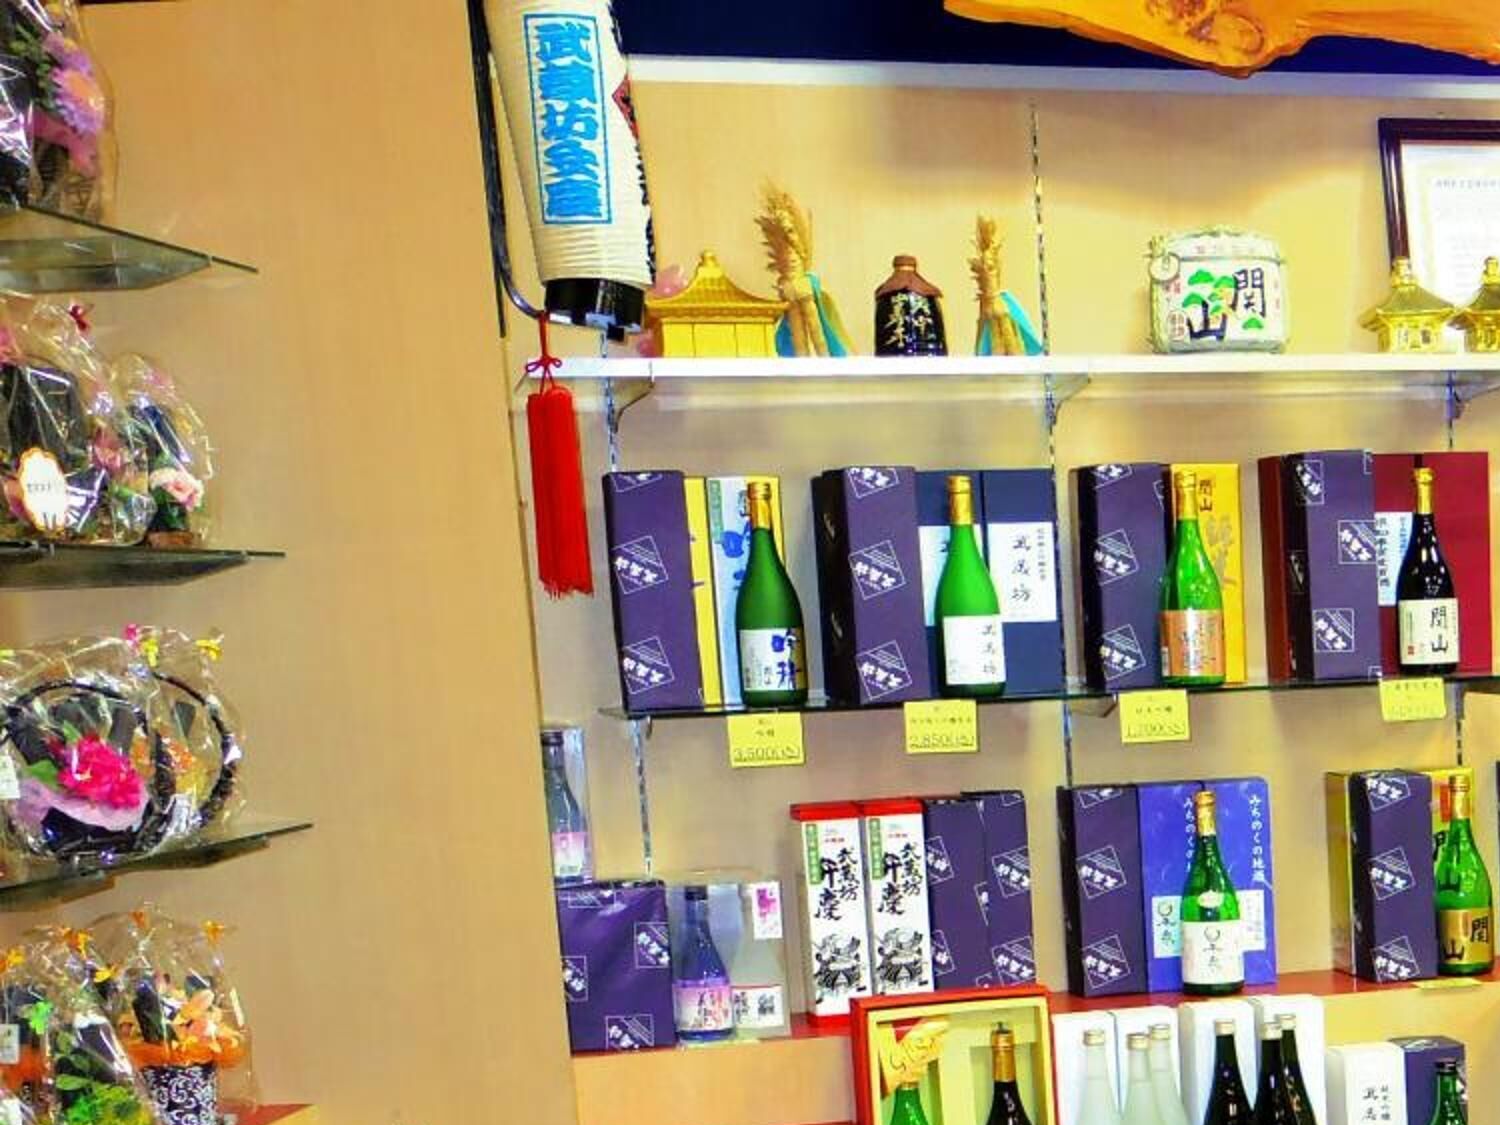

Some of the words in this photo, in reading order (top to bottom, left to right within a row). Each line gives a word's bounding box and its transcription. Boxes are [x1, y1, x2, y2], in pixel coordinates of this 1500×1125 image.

[1247, 795, 1266, 882] みちのくの地酒
